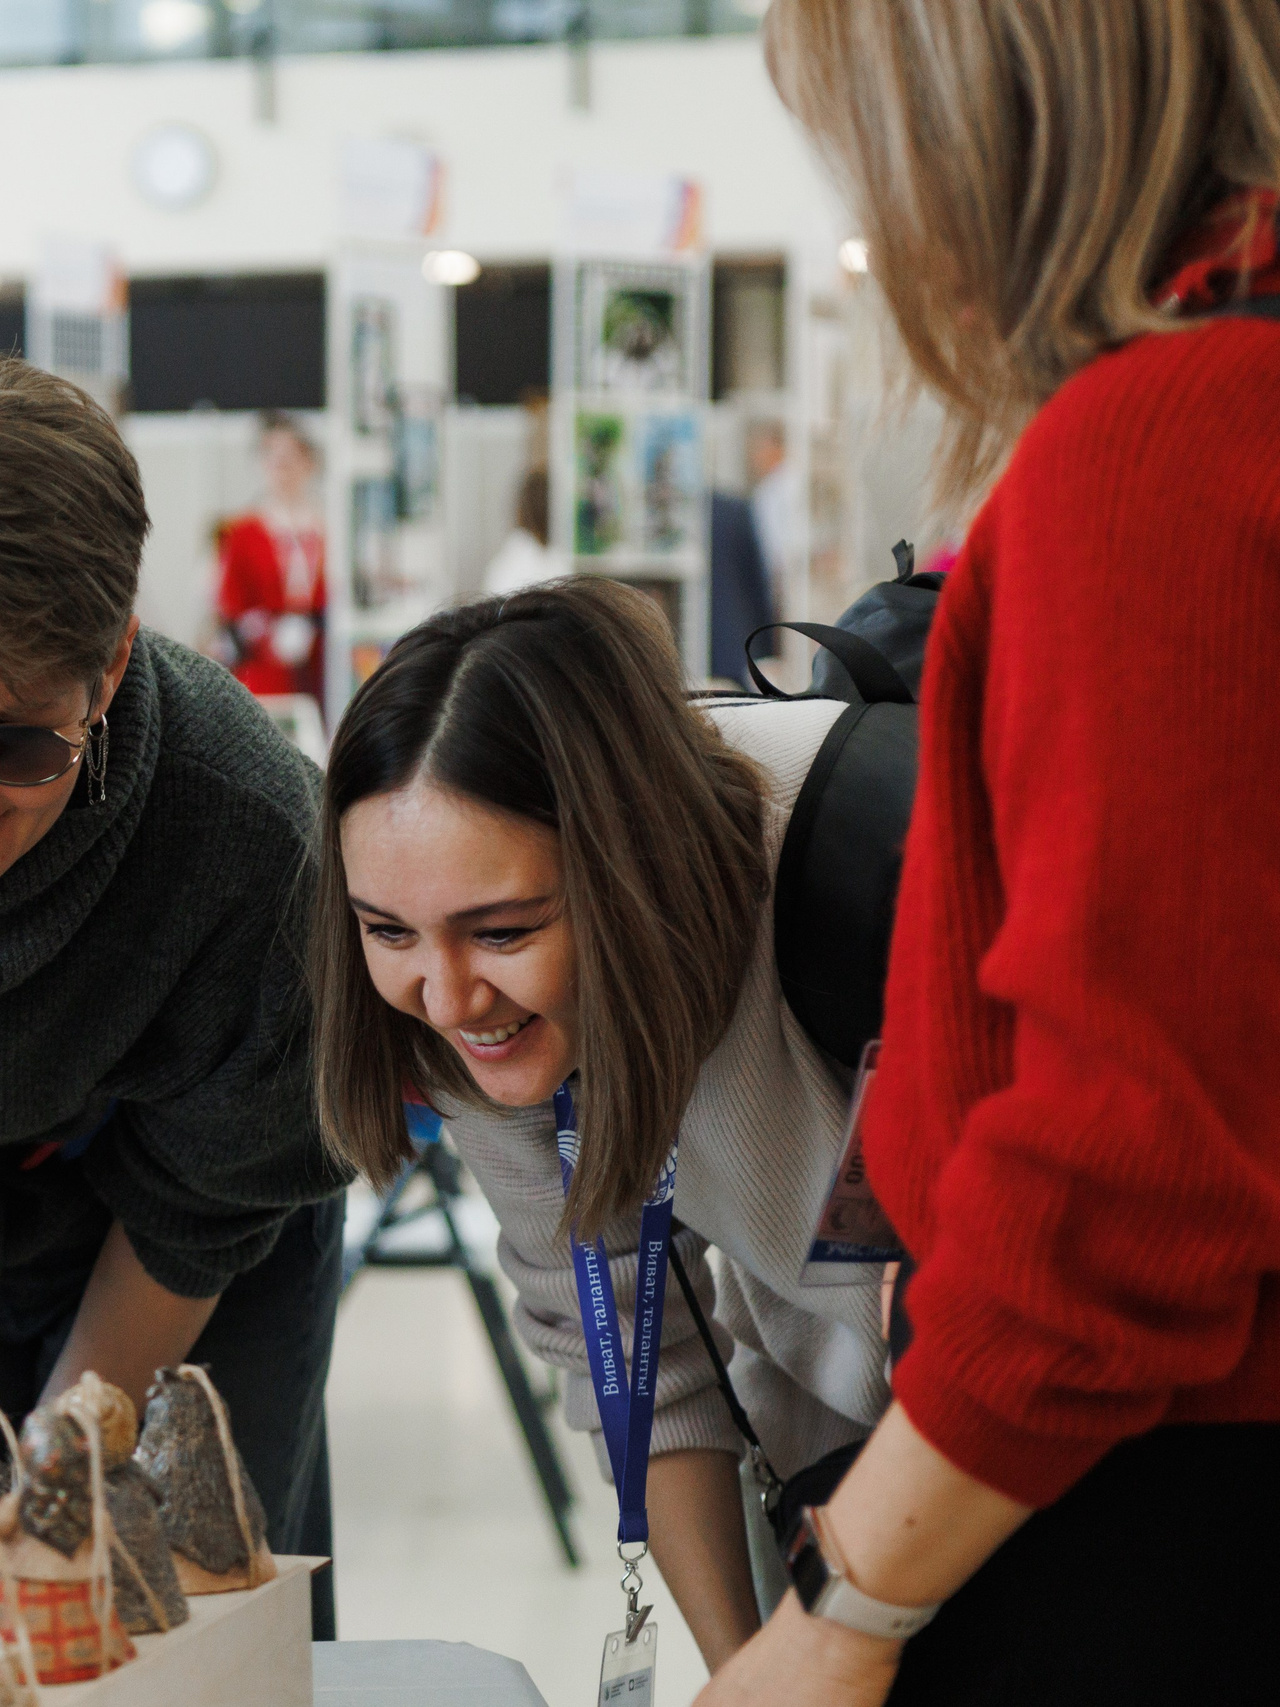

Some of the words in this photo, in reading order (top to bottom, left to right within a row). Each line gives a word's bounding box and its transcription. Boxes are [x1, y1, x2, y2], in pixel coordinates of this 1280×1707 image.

[642, 1240, 663, 1303] Виват,
[599, 1332, 620, 1397] Виват,
[637, 1306, 654, 1396] таланты!
